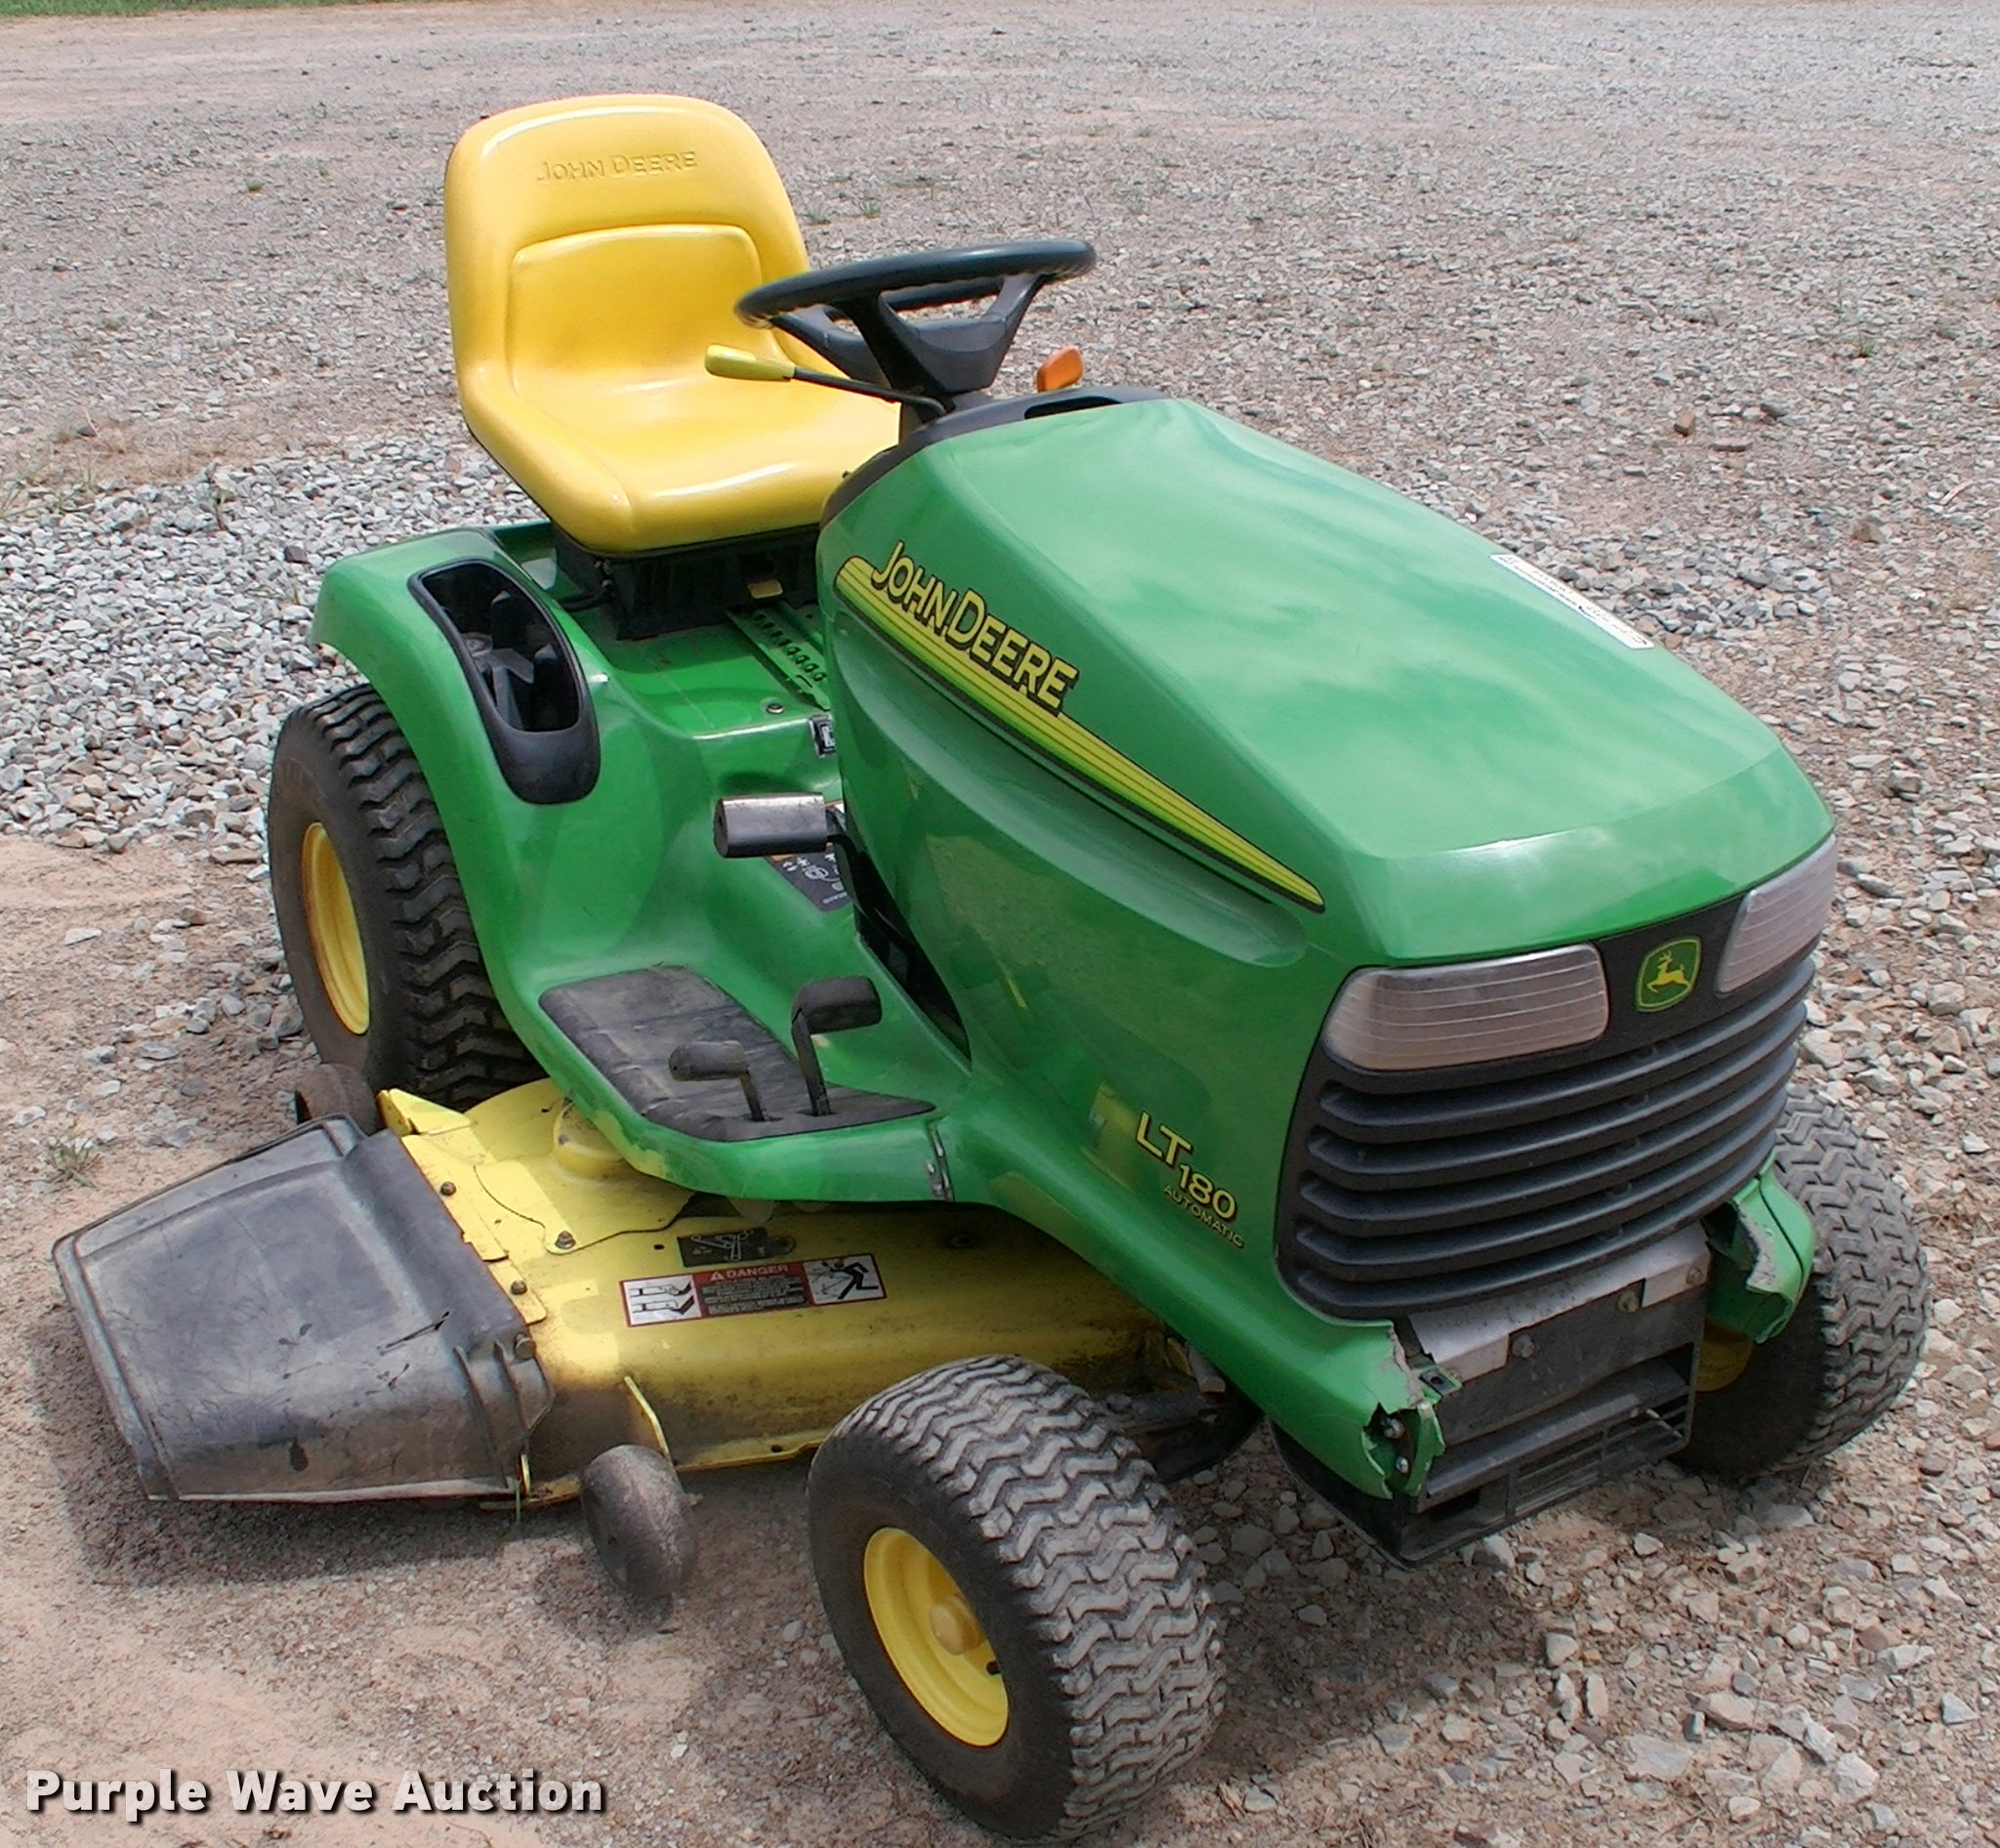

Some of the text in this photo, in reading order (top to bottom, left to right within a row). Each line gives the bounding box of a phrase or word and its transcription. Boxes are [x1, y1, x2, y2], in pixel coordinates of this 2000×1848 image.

[537, 150, 697, 183] JOHN DEERE
[871, 540, 1079, 716] JOHN DEERE
[1136, 1112, 1237, 1221] LT 180
[1164, 1185, 1245, 1248] AUTOMATIC
[726, 1264, 789, 1280] DANGER
